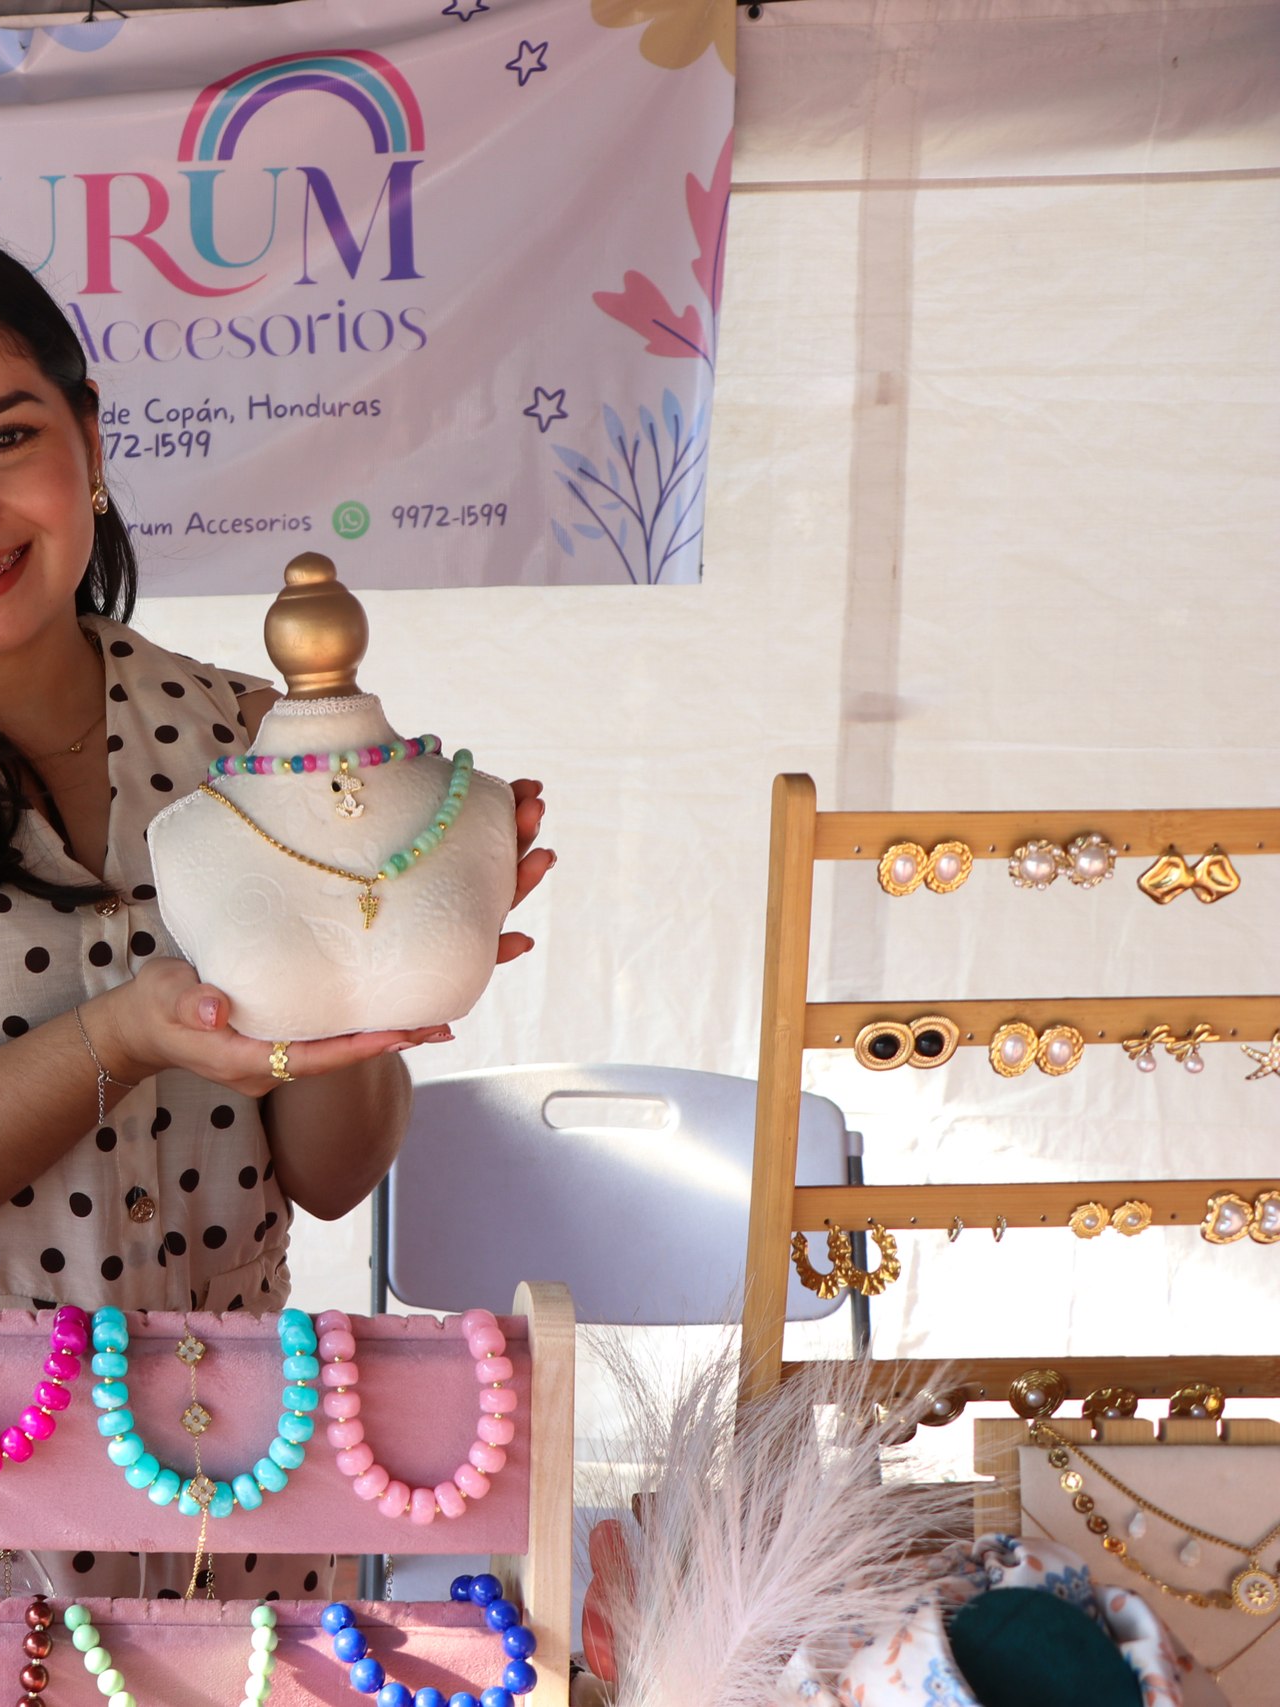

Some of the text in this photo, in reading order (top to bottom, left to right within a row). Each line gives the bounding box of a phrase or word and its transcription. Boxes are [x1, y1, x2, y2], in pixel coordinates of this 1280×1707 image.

[101, 394, 382, 428] de Copán, Honduras
[100, 430, 212, 460] 72-1599
[127, 511, 313, 536] rum Accesorios
[392, 503, 508, 529] 9972-1599
